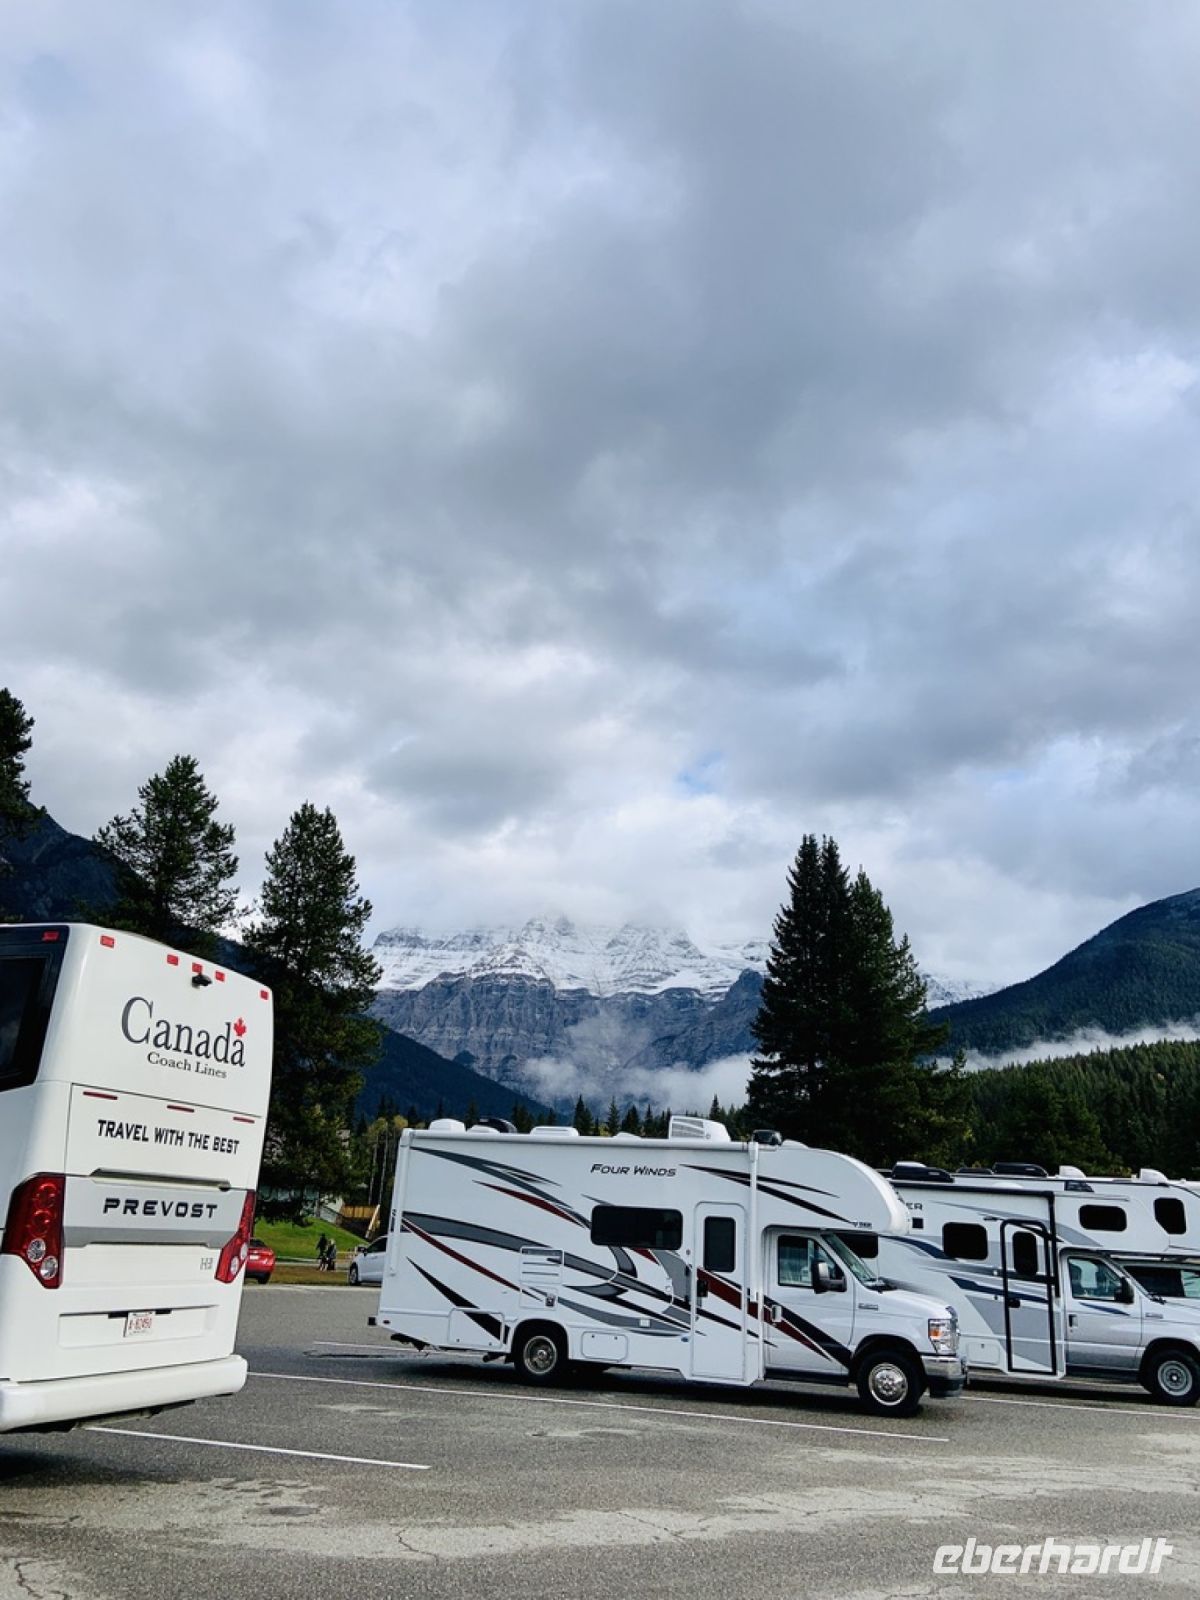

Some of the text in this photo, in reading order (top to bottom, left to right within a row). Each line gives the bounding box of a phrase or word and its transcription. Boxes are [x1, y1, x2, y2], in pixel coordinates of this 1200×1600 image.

[121, 996, 246, 1068] Canada
[147, 1051, 228, 1079] Coach Lines
[97, 1119, 240, 1155] TRAVEL WITH THE BEST
[590, 1163, 677, 1177] FOUR WINDS
[103, 1197, 218, 1219] PREVOST
